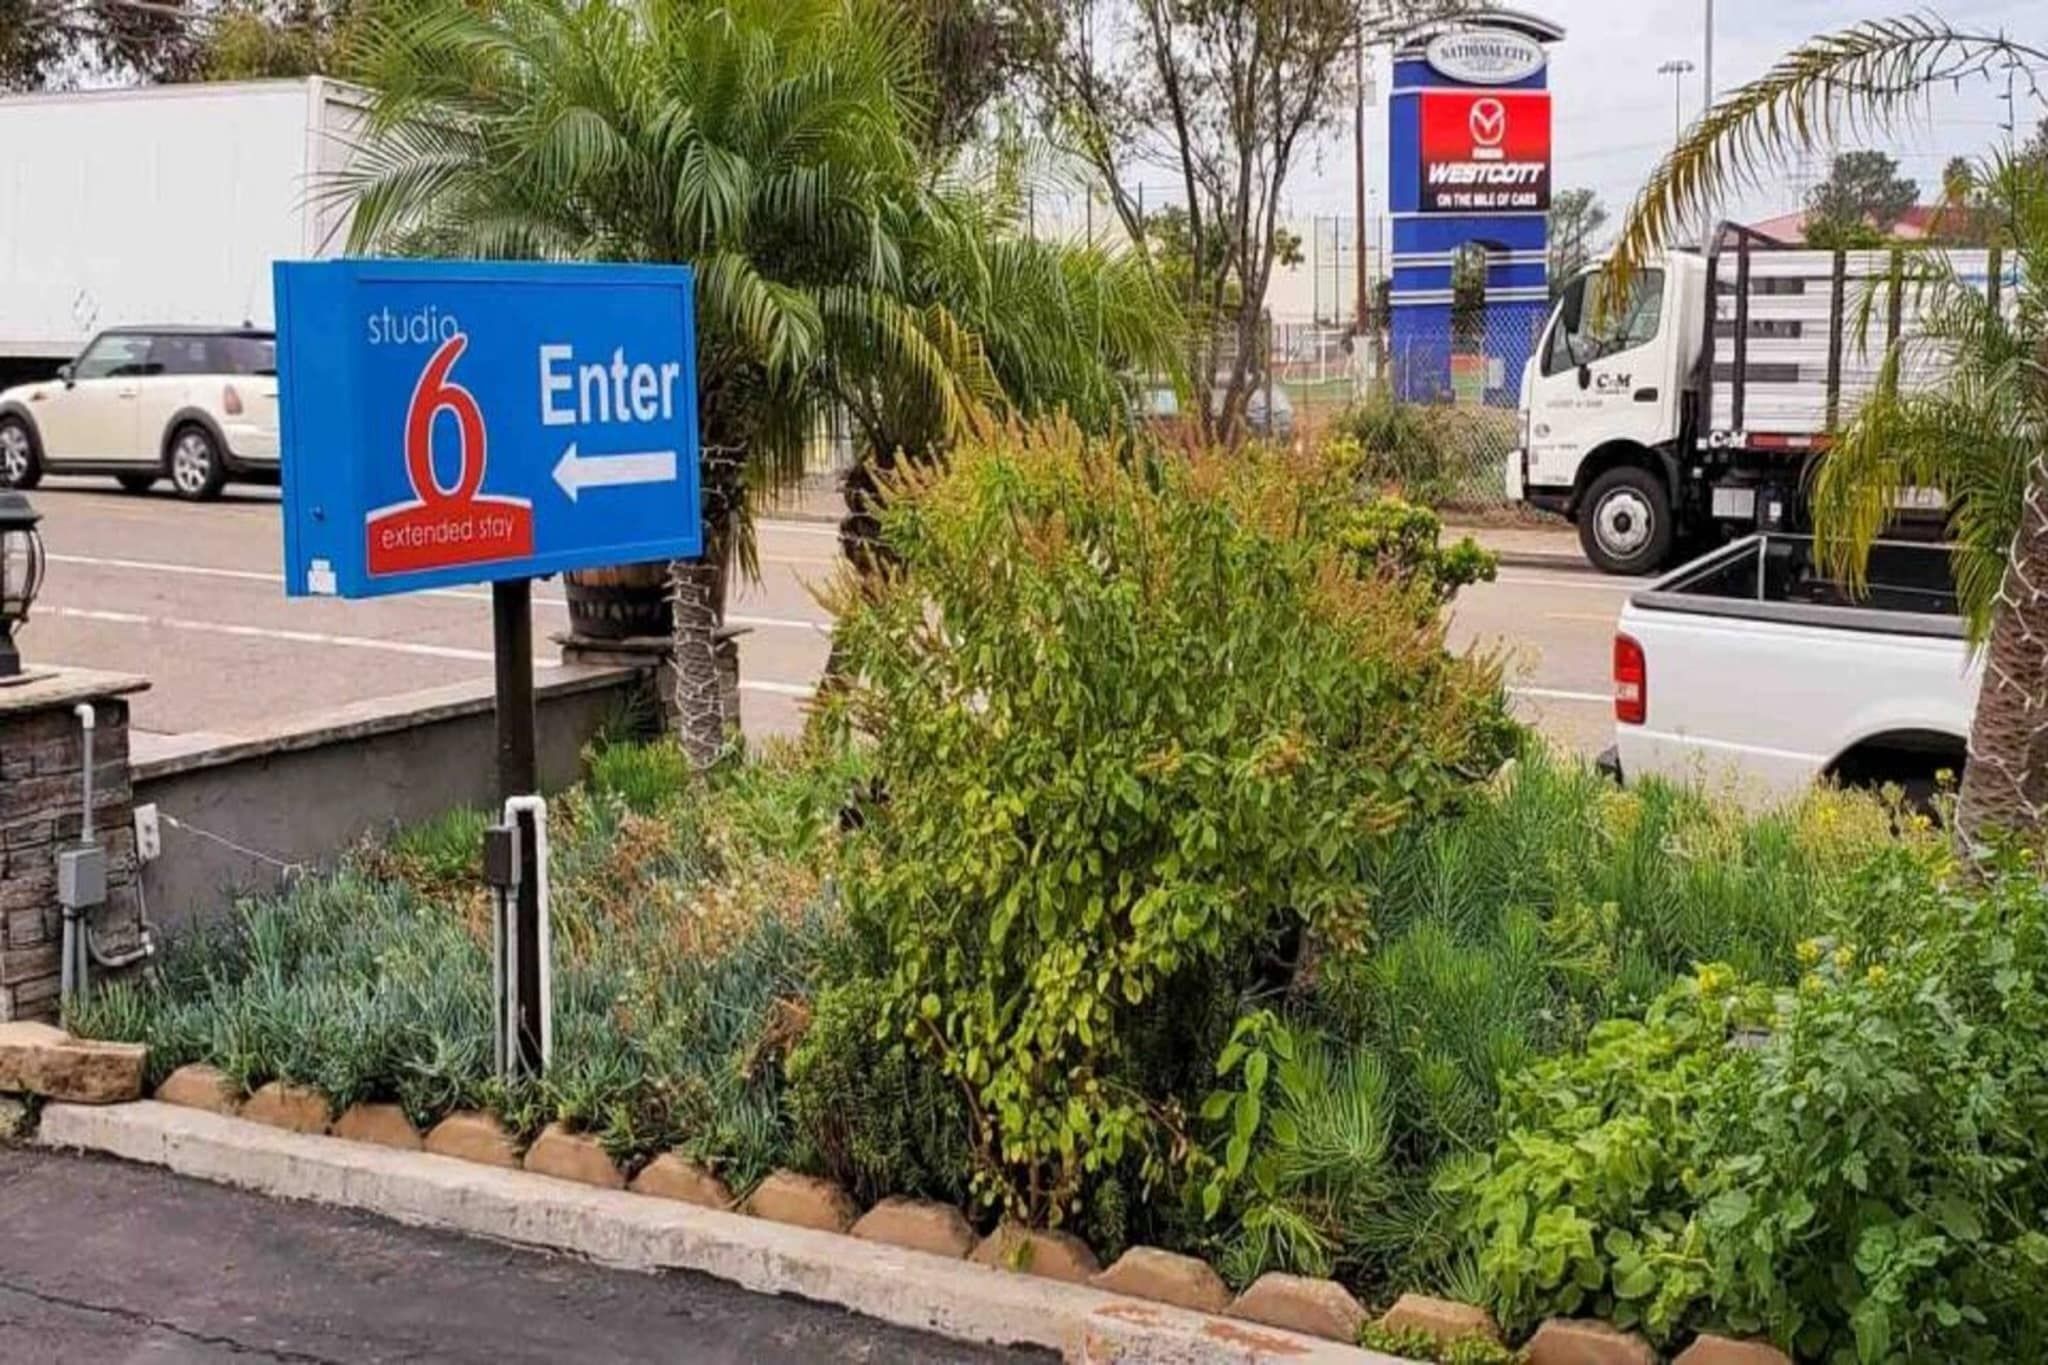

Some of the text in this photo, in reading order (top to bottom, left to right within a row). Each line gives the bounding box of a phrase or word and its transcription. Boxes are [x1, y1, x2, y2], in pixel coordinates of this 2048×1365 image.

[1428, 161, 1545, 184] WESTCOTT
[1437, 193, 1452, 207] ON
[1454, 193, 1472, 207] THE
[1497, 192, 1510, 206] OF
[367, 304, 459, 344] studio
[539, 343, 680, 426] Enter
[405, 332, 487, 505] 6
[381, 513, 515, 549] extended stay
